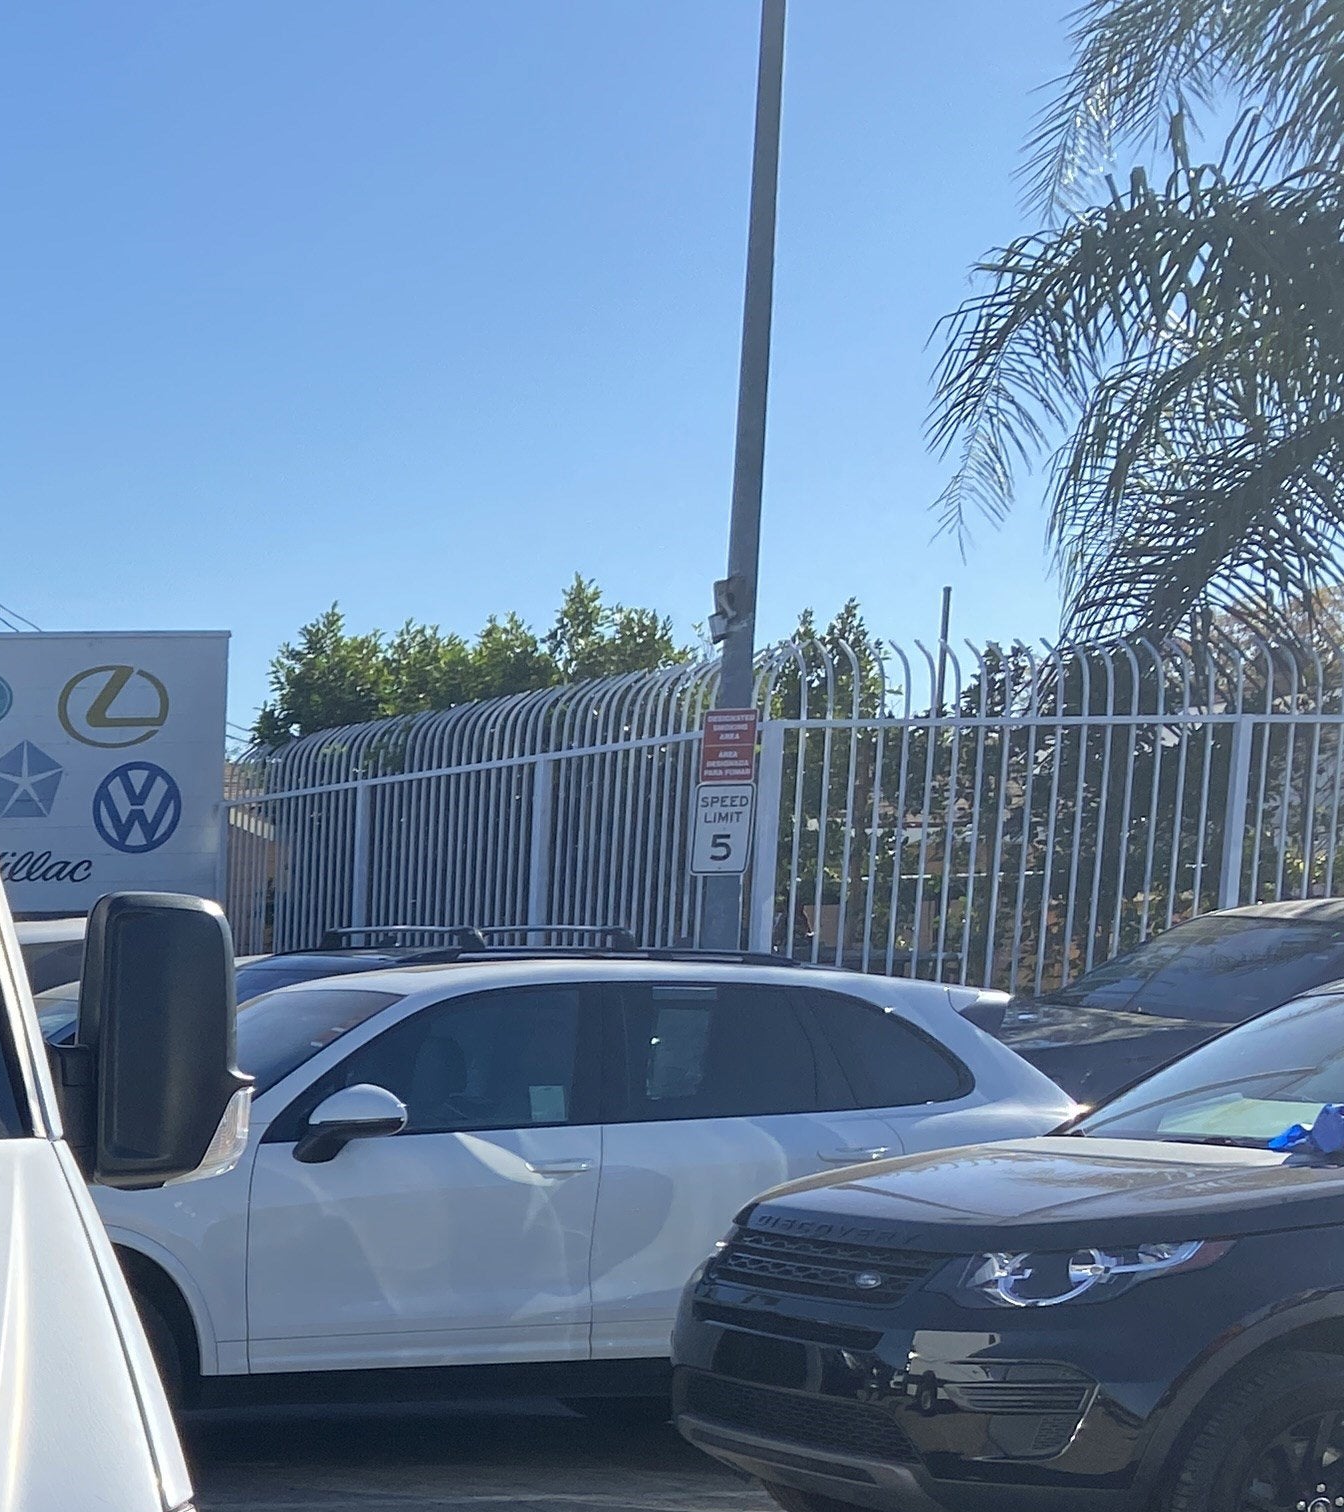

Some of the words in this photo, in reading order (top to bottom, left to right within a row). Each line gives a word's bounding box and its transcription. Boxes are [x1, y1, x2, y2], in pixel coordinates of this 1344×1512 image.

[700, 795, 749, 808] SPEED
[704, 811, 743, 824] LIMIT
[710, 834, 732, 861] 5
